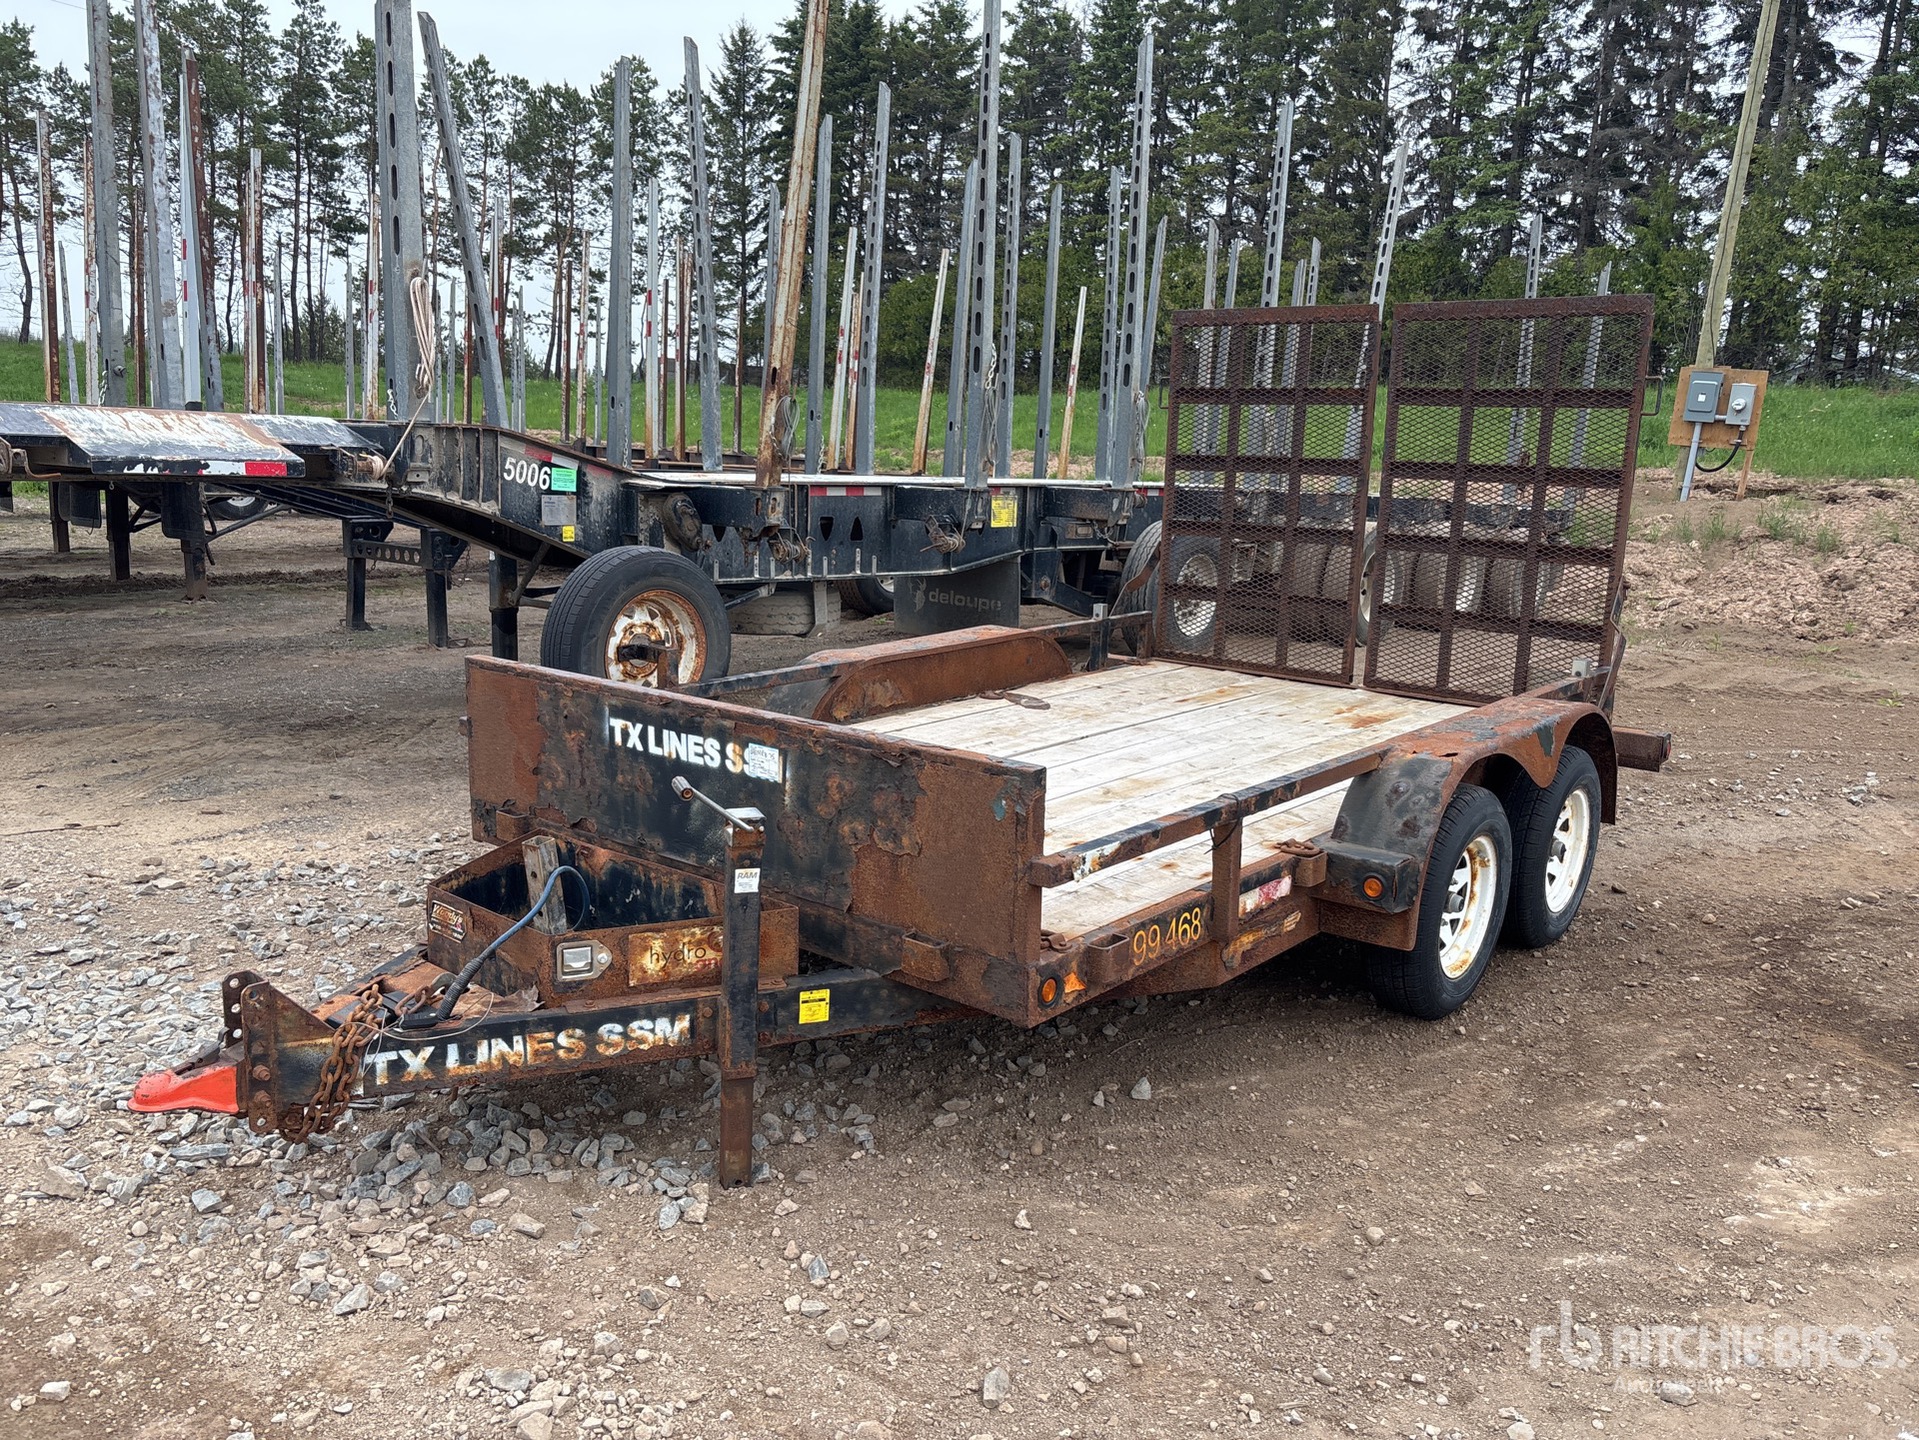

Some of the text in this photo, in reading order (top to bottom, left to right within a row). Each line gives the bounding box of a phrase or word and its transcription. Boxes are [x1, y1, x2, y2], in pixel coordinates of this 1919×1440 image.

[503, 457, 552, 490] 5006
[928, 588, 1002, 612] deloupe
[609, 717, 644, 751] TX
[647, 725, 722, 768] LINES
[736, 871, 759, 880] RAM
[648, 941, 707, 968] hydro
[362, 1013, 693, 1087] TX LINES SSM
